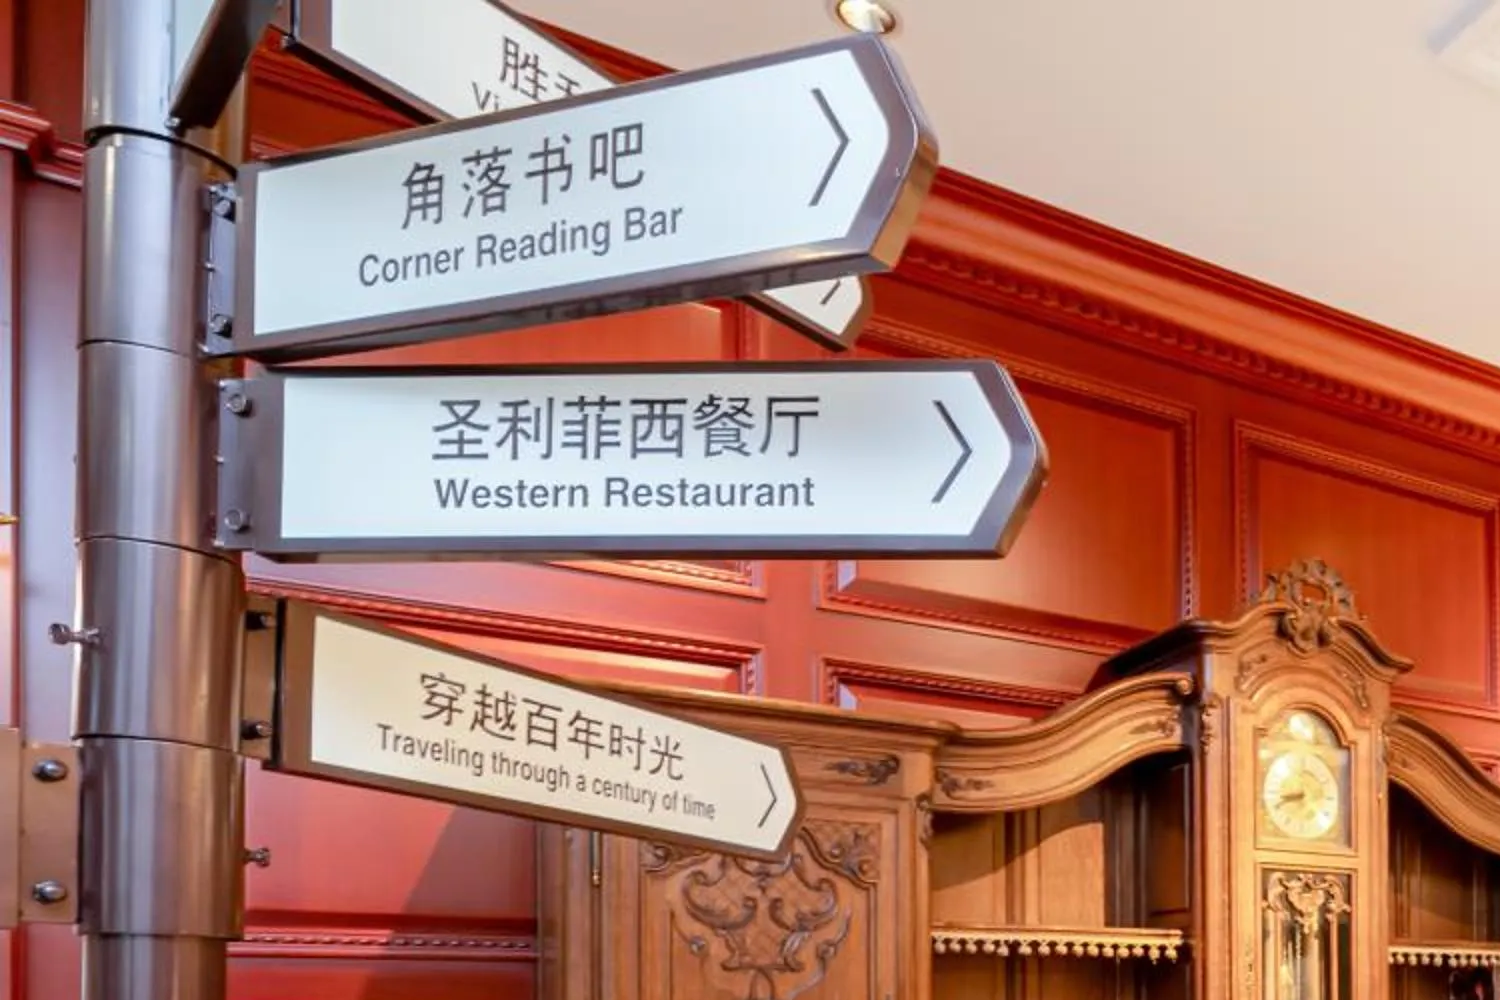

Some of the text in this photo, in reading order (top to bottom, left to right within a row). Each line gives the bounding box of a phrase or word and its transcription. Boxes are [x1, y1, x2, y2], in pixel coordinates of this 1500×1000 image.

[401, 122, 645, 230] 角落书吧
[358, 206, 685, 287] Corner Reading Bar
[432, 394, 820, 460] 圣利菲西餐厅
[433, 477, 815, 509] Western Restaurant
[420, 672, 684, 781] 穿越百年时光
[376, 723, 717, 821] Traveling through a century of time
